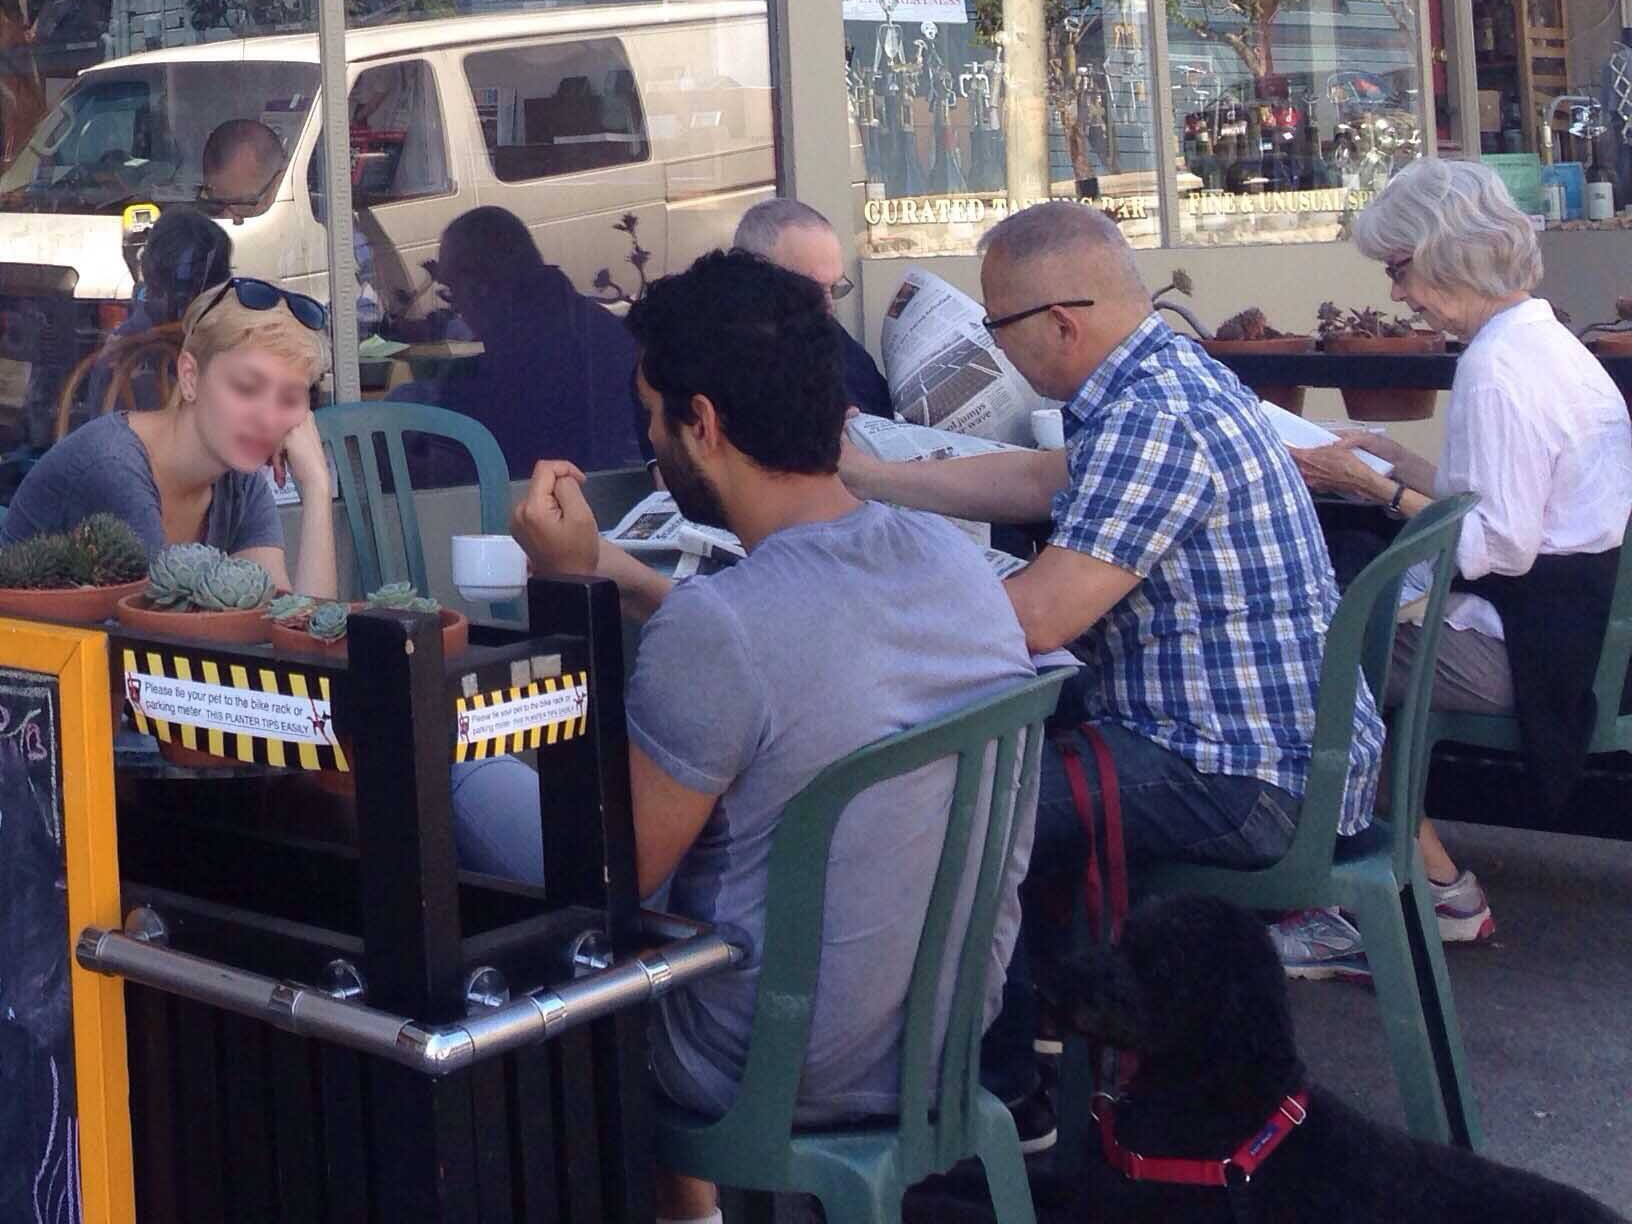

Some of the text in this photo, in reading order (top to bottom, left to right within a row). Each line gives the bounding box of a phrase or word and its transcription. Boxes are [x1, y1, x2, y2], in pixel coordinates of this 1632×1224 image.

[864, 198, 985, 224] CURATED
[1189, 193, 1236, 214] FINE
[1240, 193, 1255, 212] &
[1259, 189, 1345, 213] UNUSUAL
[145, 681, 172, 697] Please
[187, 690, 206, 702] your
[208, 693, 222, 707] pet
[224, 695, 232, 706] to
[235, 694, 248, 708] the
[251, 696, 269, 711] bike
[271, 701, 291, 715] rack
[293, 707, 303, 716] or
[145, 699, 176, 716] parking
[207, 710, 223, 721] THIS
[225, 713, 260, 727] PLANTER
[262, 718, 279, 730] TIPS
[281, 722, 309, 734] EASILY
